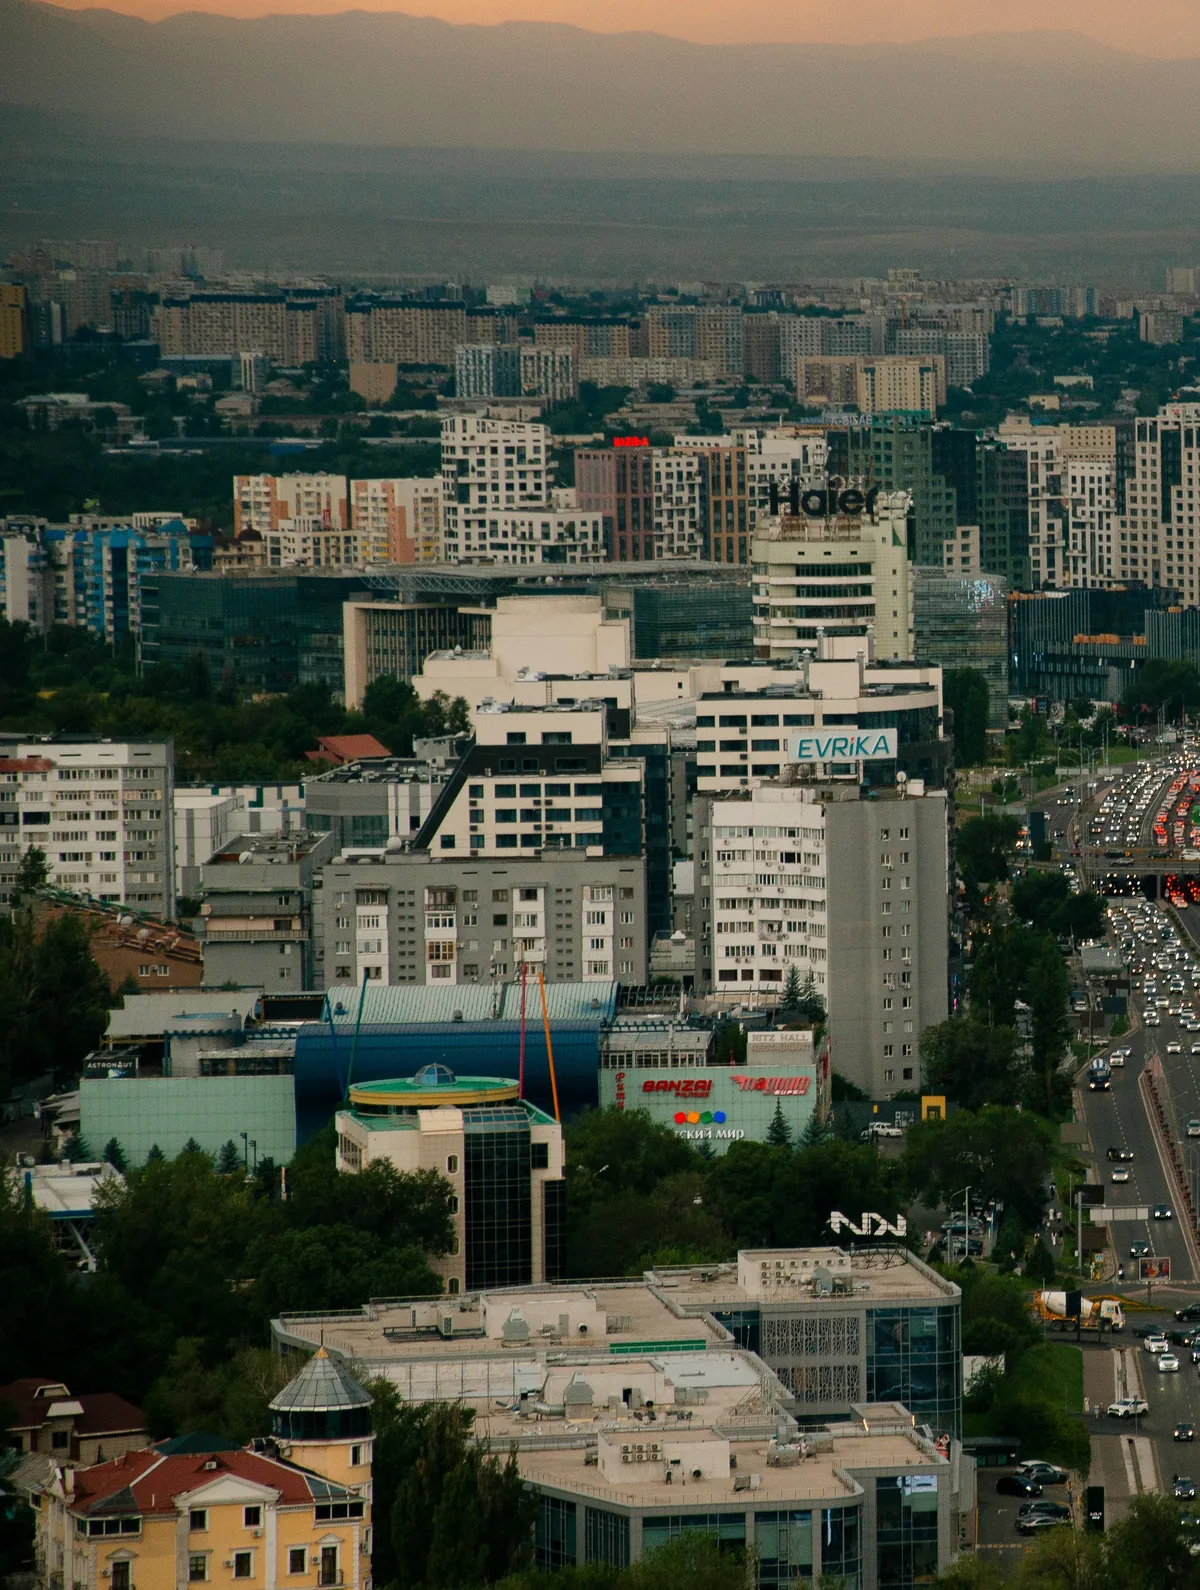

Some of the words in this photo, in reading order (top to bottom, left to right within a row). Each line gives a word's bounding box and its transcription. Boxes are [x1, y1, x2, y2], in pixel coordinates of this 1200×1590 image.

[769, 481, 879, 517] Haier
[752, 1034, 776, 1042] RITZ
[780, 1034, 809, 1042] HALL
[642, 1079, 713, 1093] BANZAI
[715, 1128, 745, 1141] мир
